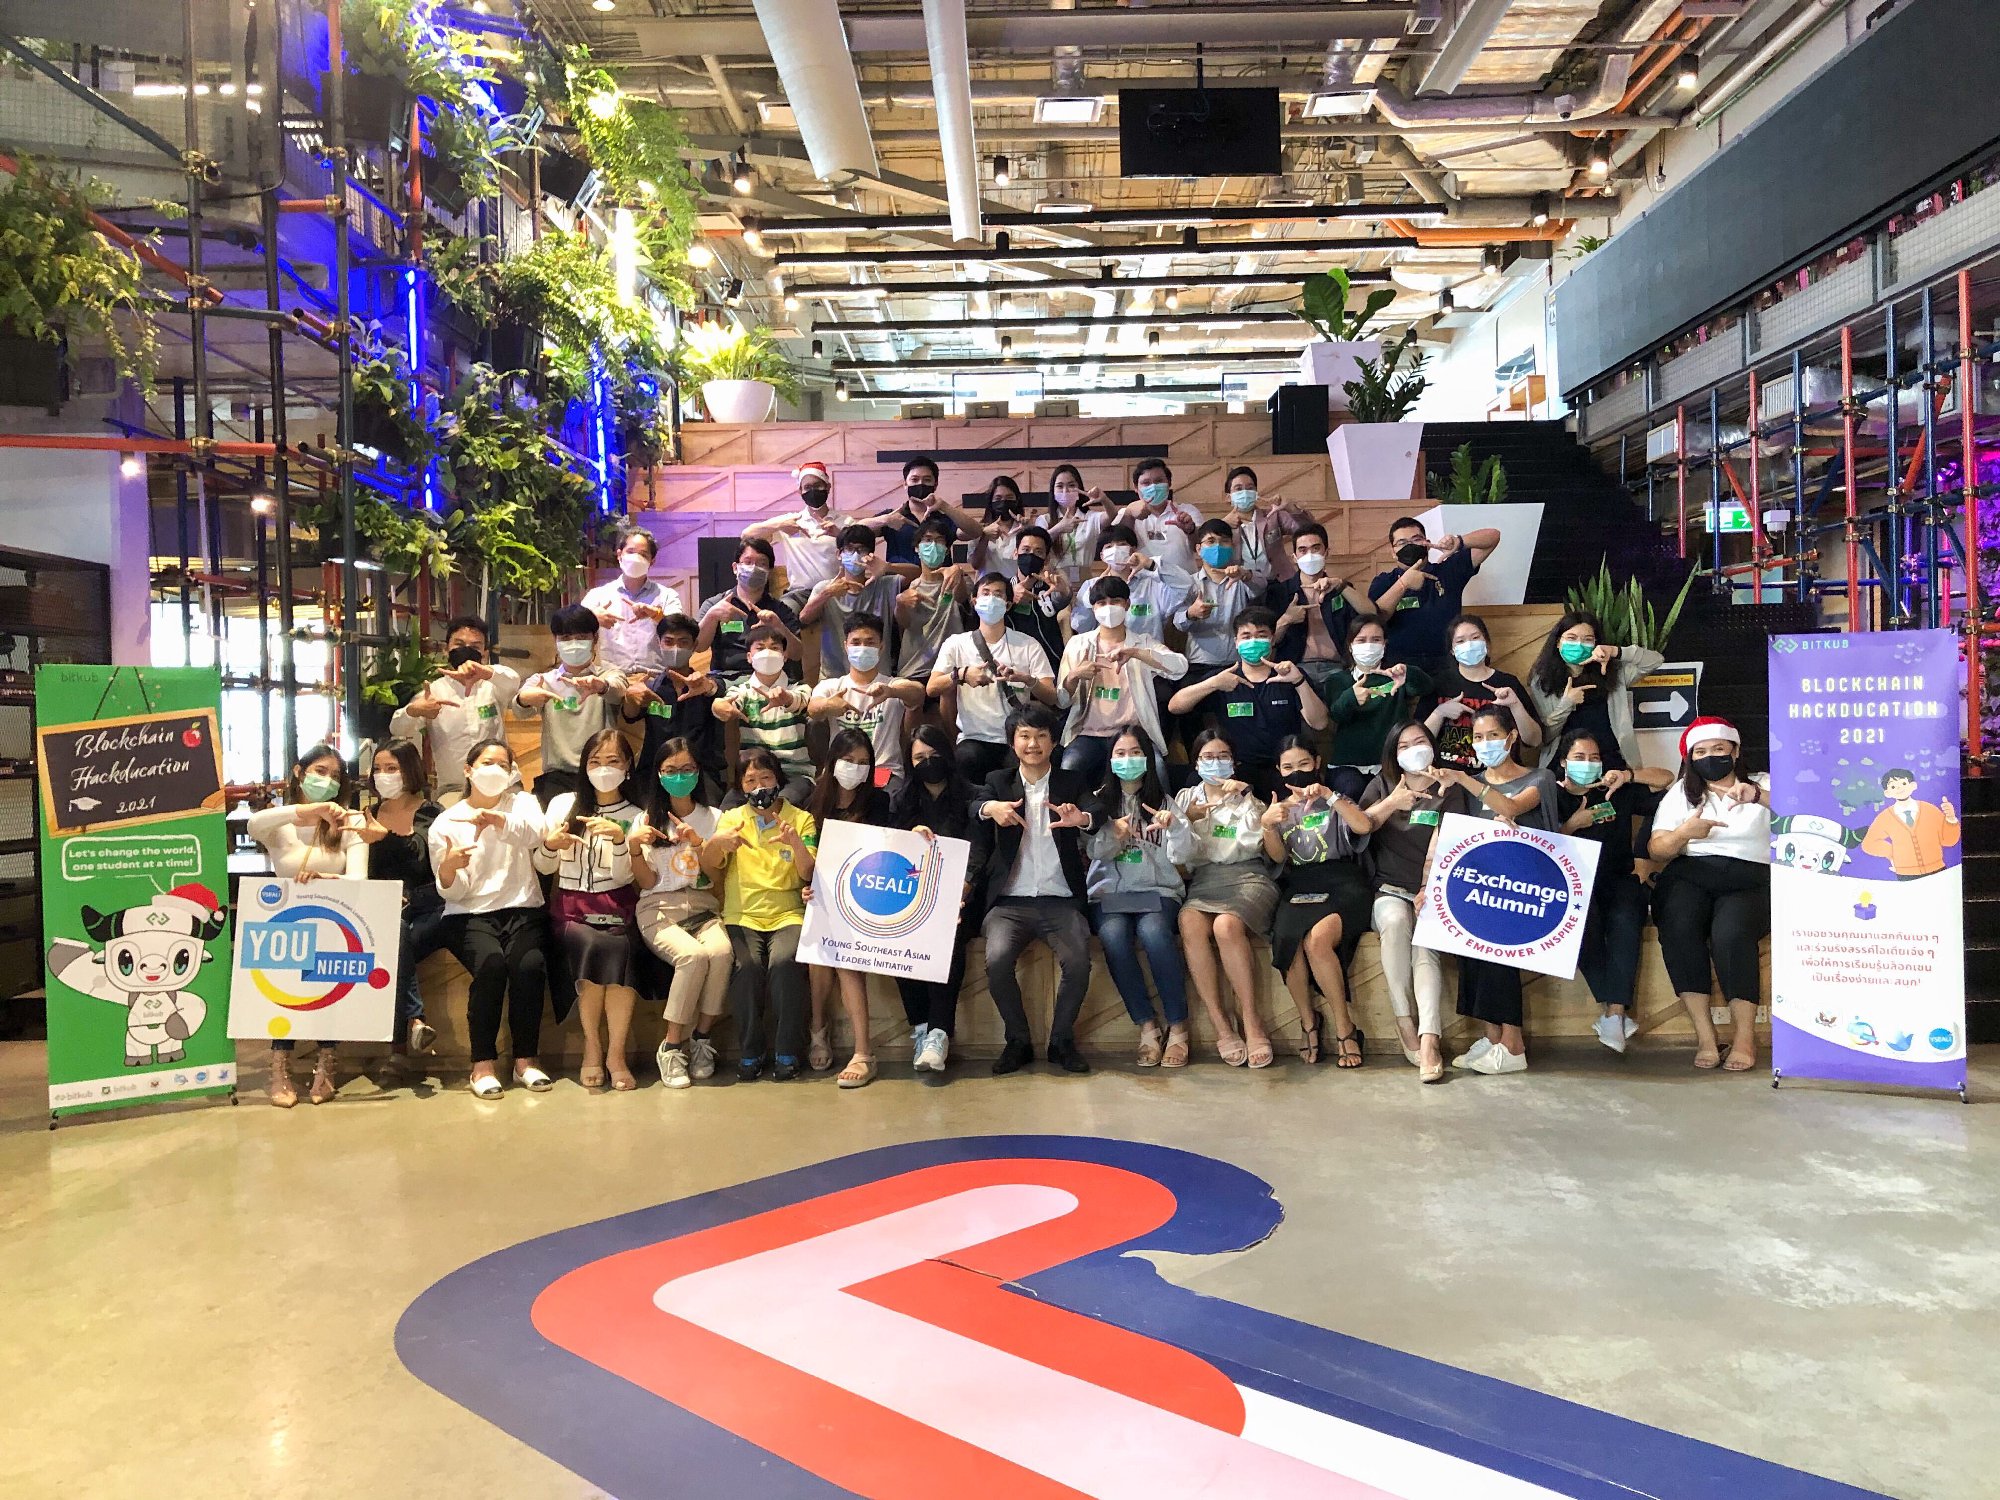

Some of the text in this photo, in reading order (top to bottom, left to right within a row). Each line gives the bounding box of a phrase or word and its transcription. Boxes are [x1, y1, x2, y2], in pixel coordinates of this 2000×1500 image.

[1802, 639, 1849, 650] BITKUB
[1801, 675, 1924, 693] BLOCKCHAIN
[1789, 700, 1938, 719] HACKDUCATION
[75, 724, 174, 758] Blockchain
[1840, 728, 1885, 744] 2021
[70, 757, 190, 791] Hackducation
[116, 796, 157, 814] 2021
[69, 845, 196, 859] Let's change the world,
[72, 863, 94, 871] one
[97, 860, 140, 870] student
[142, 860, 155, 868] at
[165, 858, 193, 867] time!
[1439, 829, 1583, 897] CONNECT EMPOWER INSPIRE
[855, 873, 913, 895] YSEALI
[1452, 866, 1568, 903] #Exchange
[1465, 889, 1546, 918] Alumni
[1433, 886, 1579, 958] CONNECT EMPOWER INSPIRE
[249, 929, 310, 962] YOU
[822, 936, 931, 961] YOUNG SOUTHEAST ASIAN
[317, 960, 367, 976] NIFIED
[835, 952, 913, 972] LEADERS INITIATIVE
